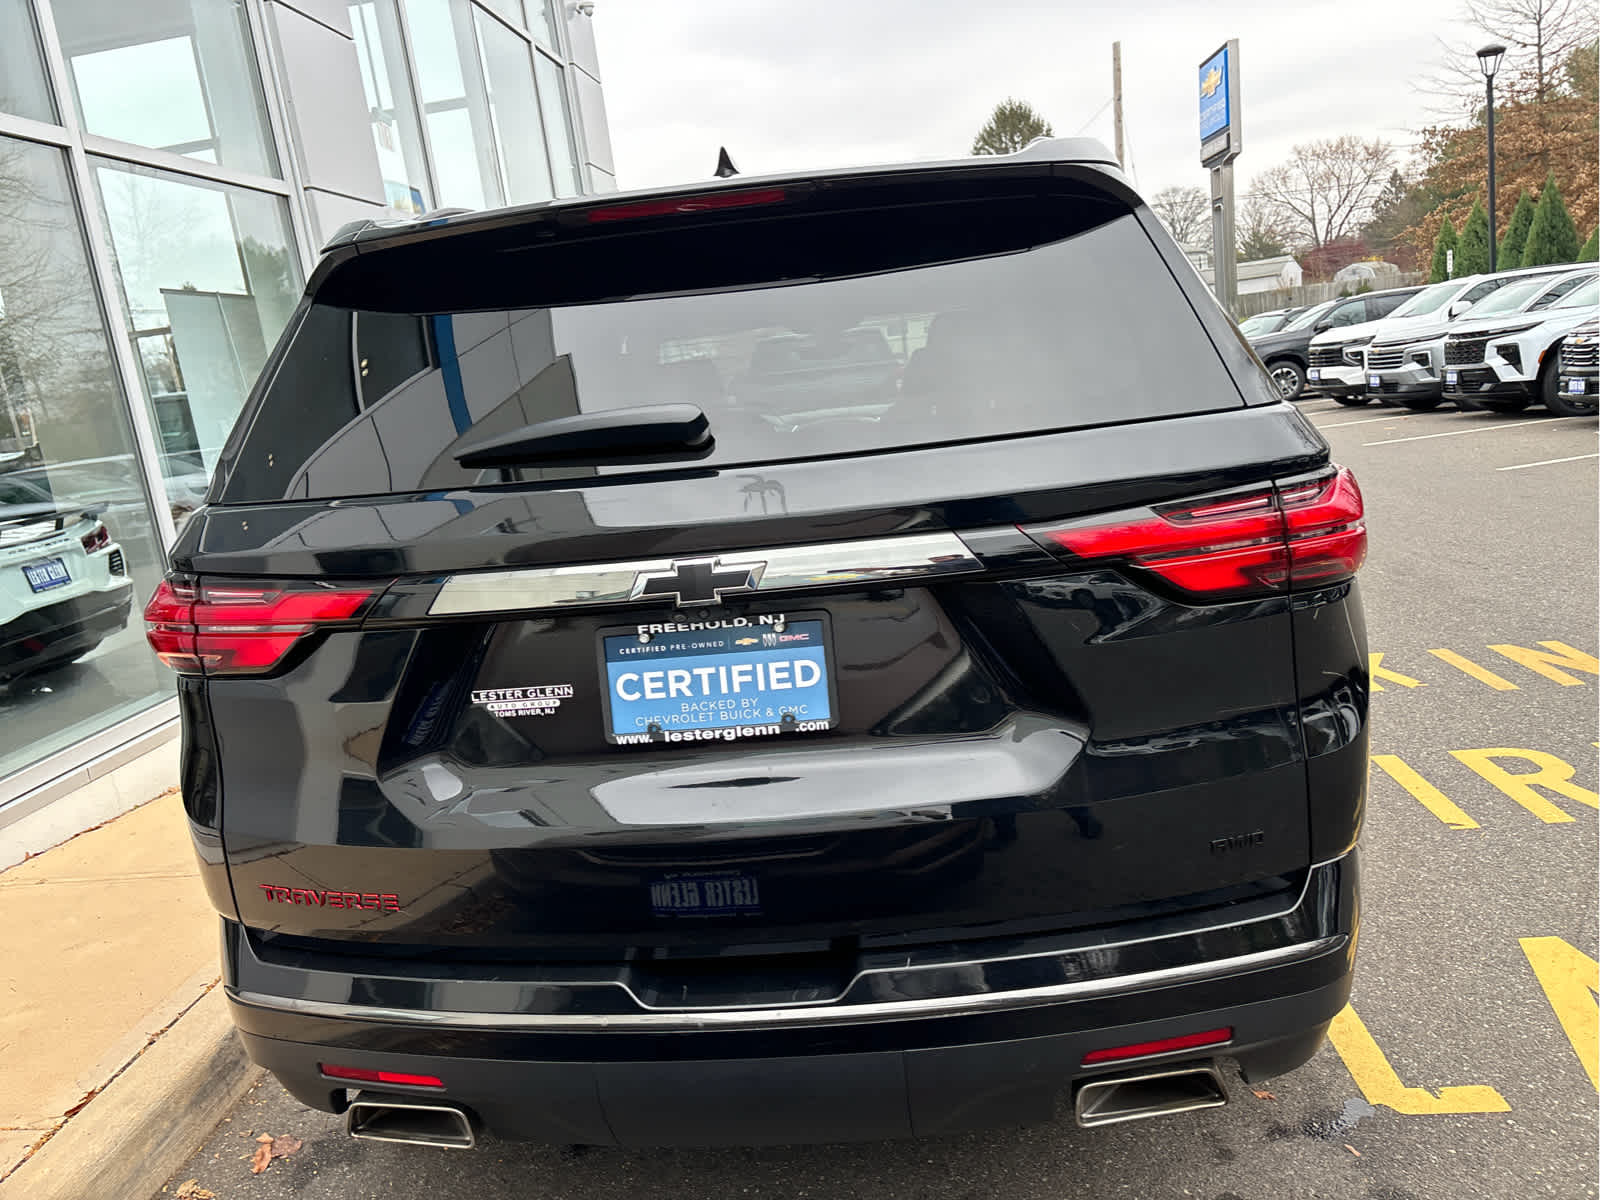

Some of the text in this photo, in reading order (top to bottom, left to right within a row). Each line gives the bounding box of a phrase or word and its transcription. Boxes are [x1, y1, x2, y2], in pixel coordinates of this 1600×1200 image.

[637, 614, 785, 634] FREEHOLD, NJ
[779, 633, 810, 642] GMC
[619, 640, 724, 655] CERTIFIED PRE-OWNED
[616, 659, 821, 701] CERTIFIED
[471, 686, 574, 702] LESTER GLENN
[490, 700, 557, 711] AUTO GROUP
[494, 706, 555, 718] TOMS RIVER, NJ
[681, 697, 760, 713] BACKED BY
[635, 704, 808, 727] CHEVROLET BUICK & GMC
[664, 725, 781, 743] lesterglenn
[258, 883, 401, 913] TRAVERSE
